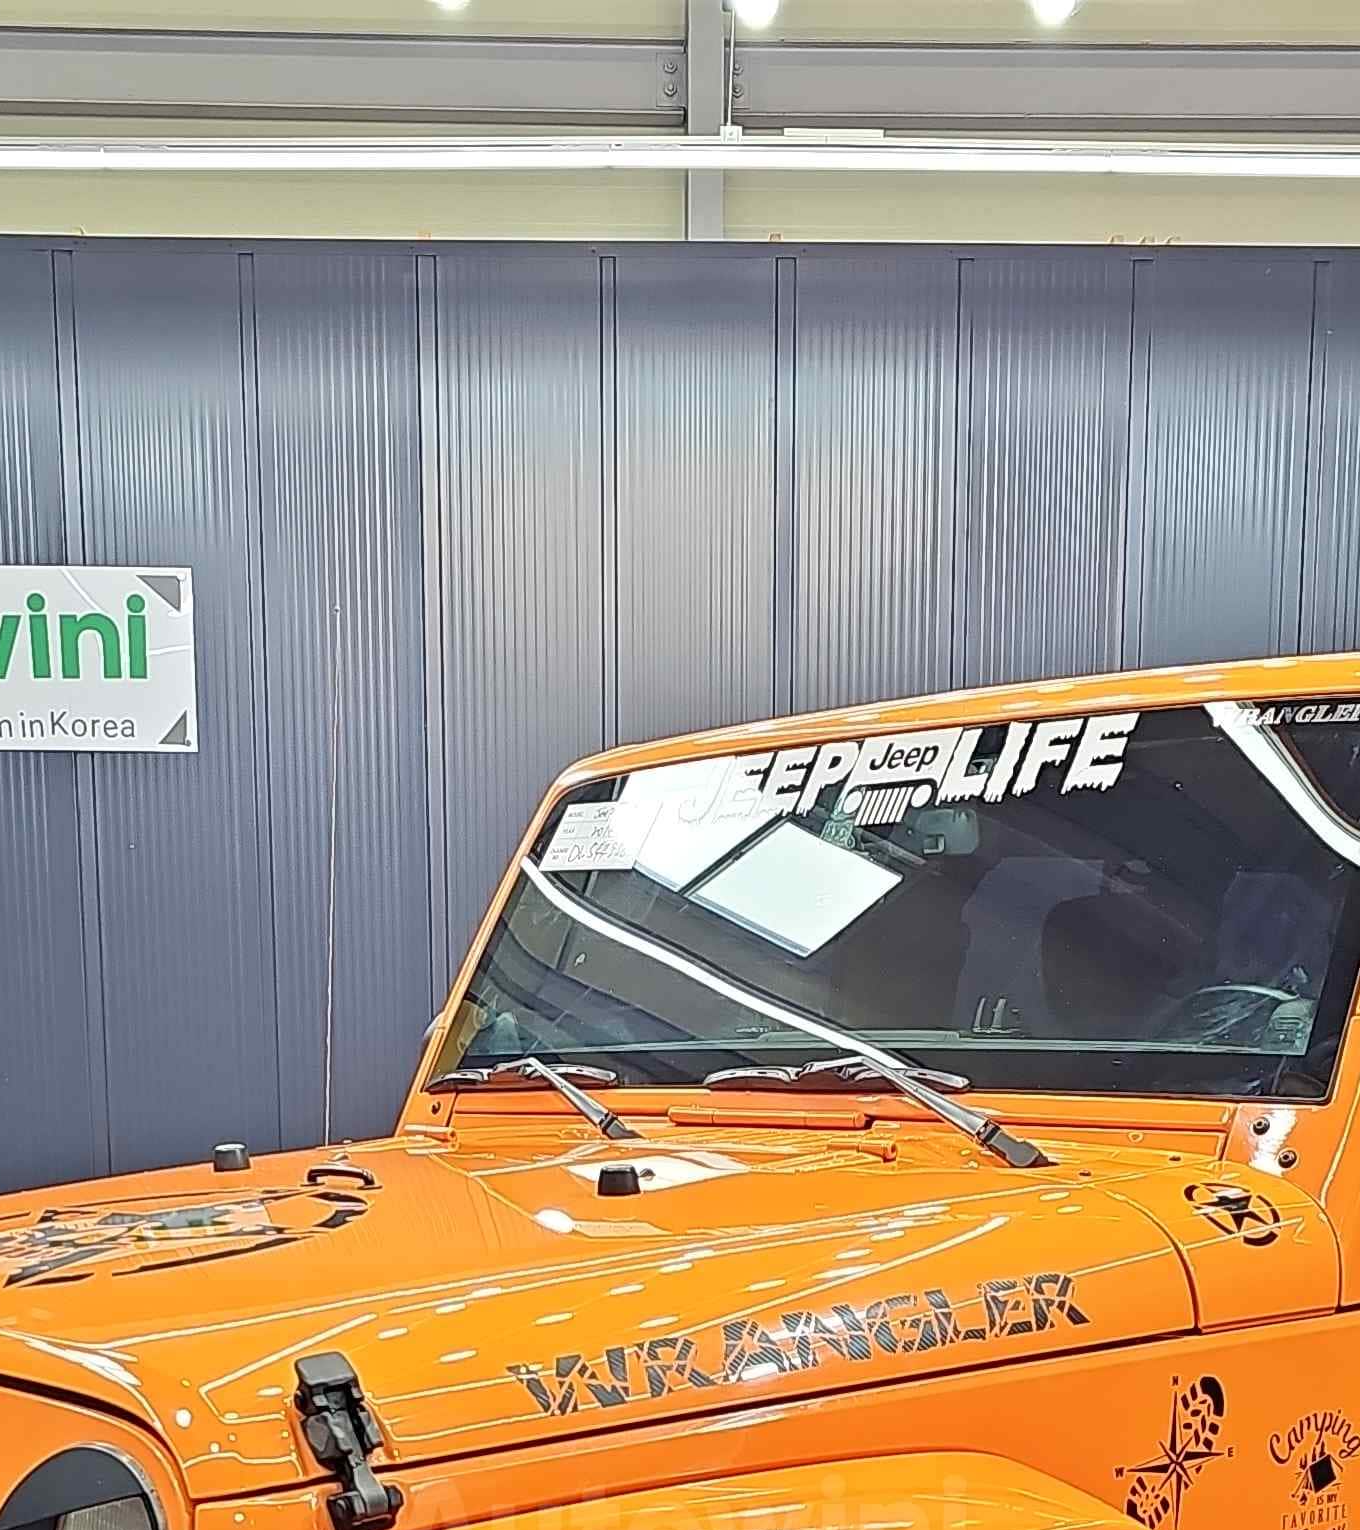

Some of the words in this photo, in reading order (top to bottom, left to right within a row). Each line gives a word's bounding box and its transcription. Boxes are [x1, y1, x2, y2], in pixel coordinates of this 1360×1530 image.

[20, 712, 44, 738] in
[50, 711, 136, 738] Korea
[868, 741, 940, 773] Jeep
[937, 712, 1141, 806] LIFE
[506, 1273, 1091, 1416] WRANGLER
